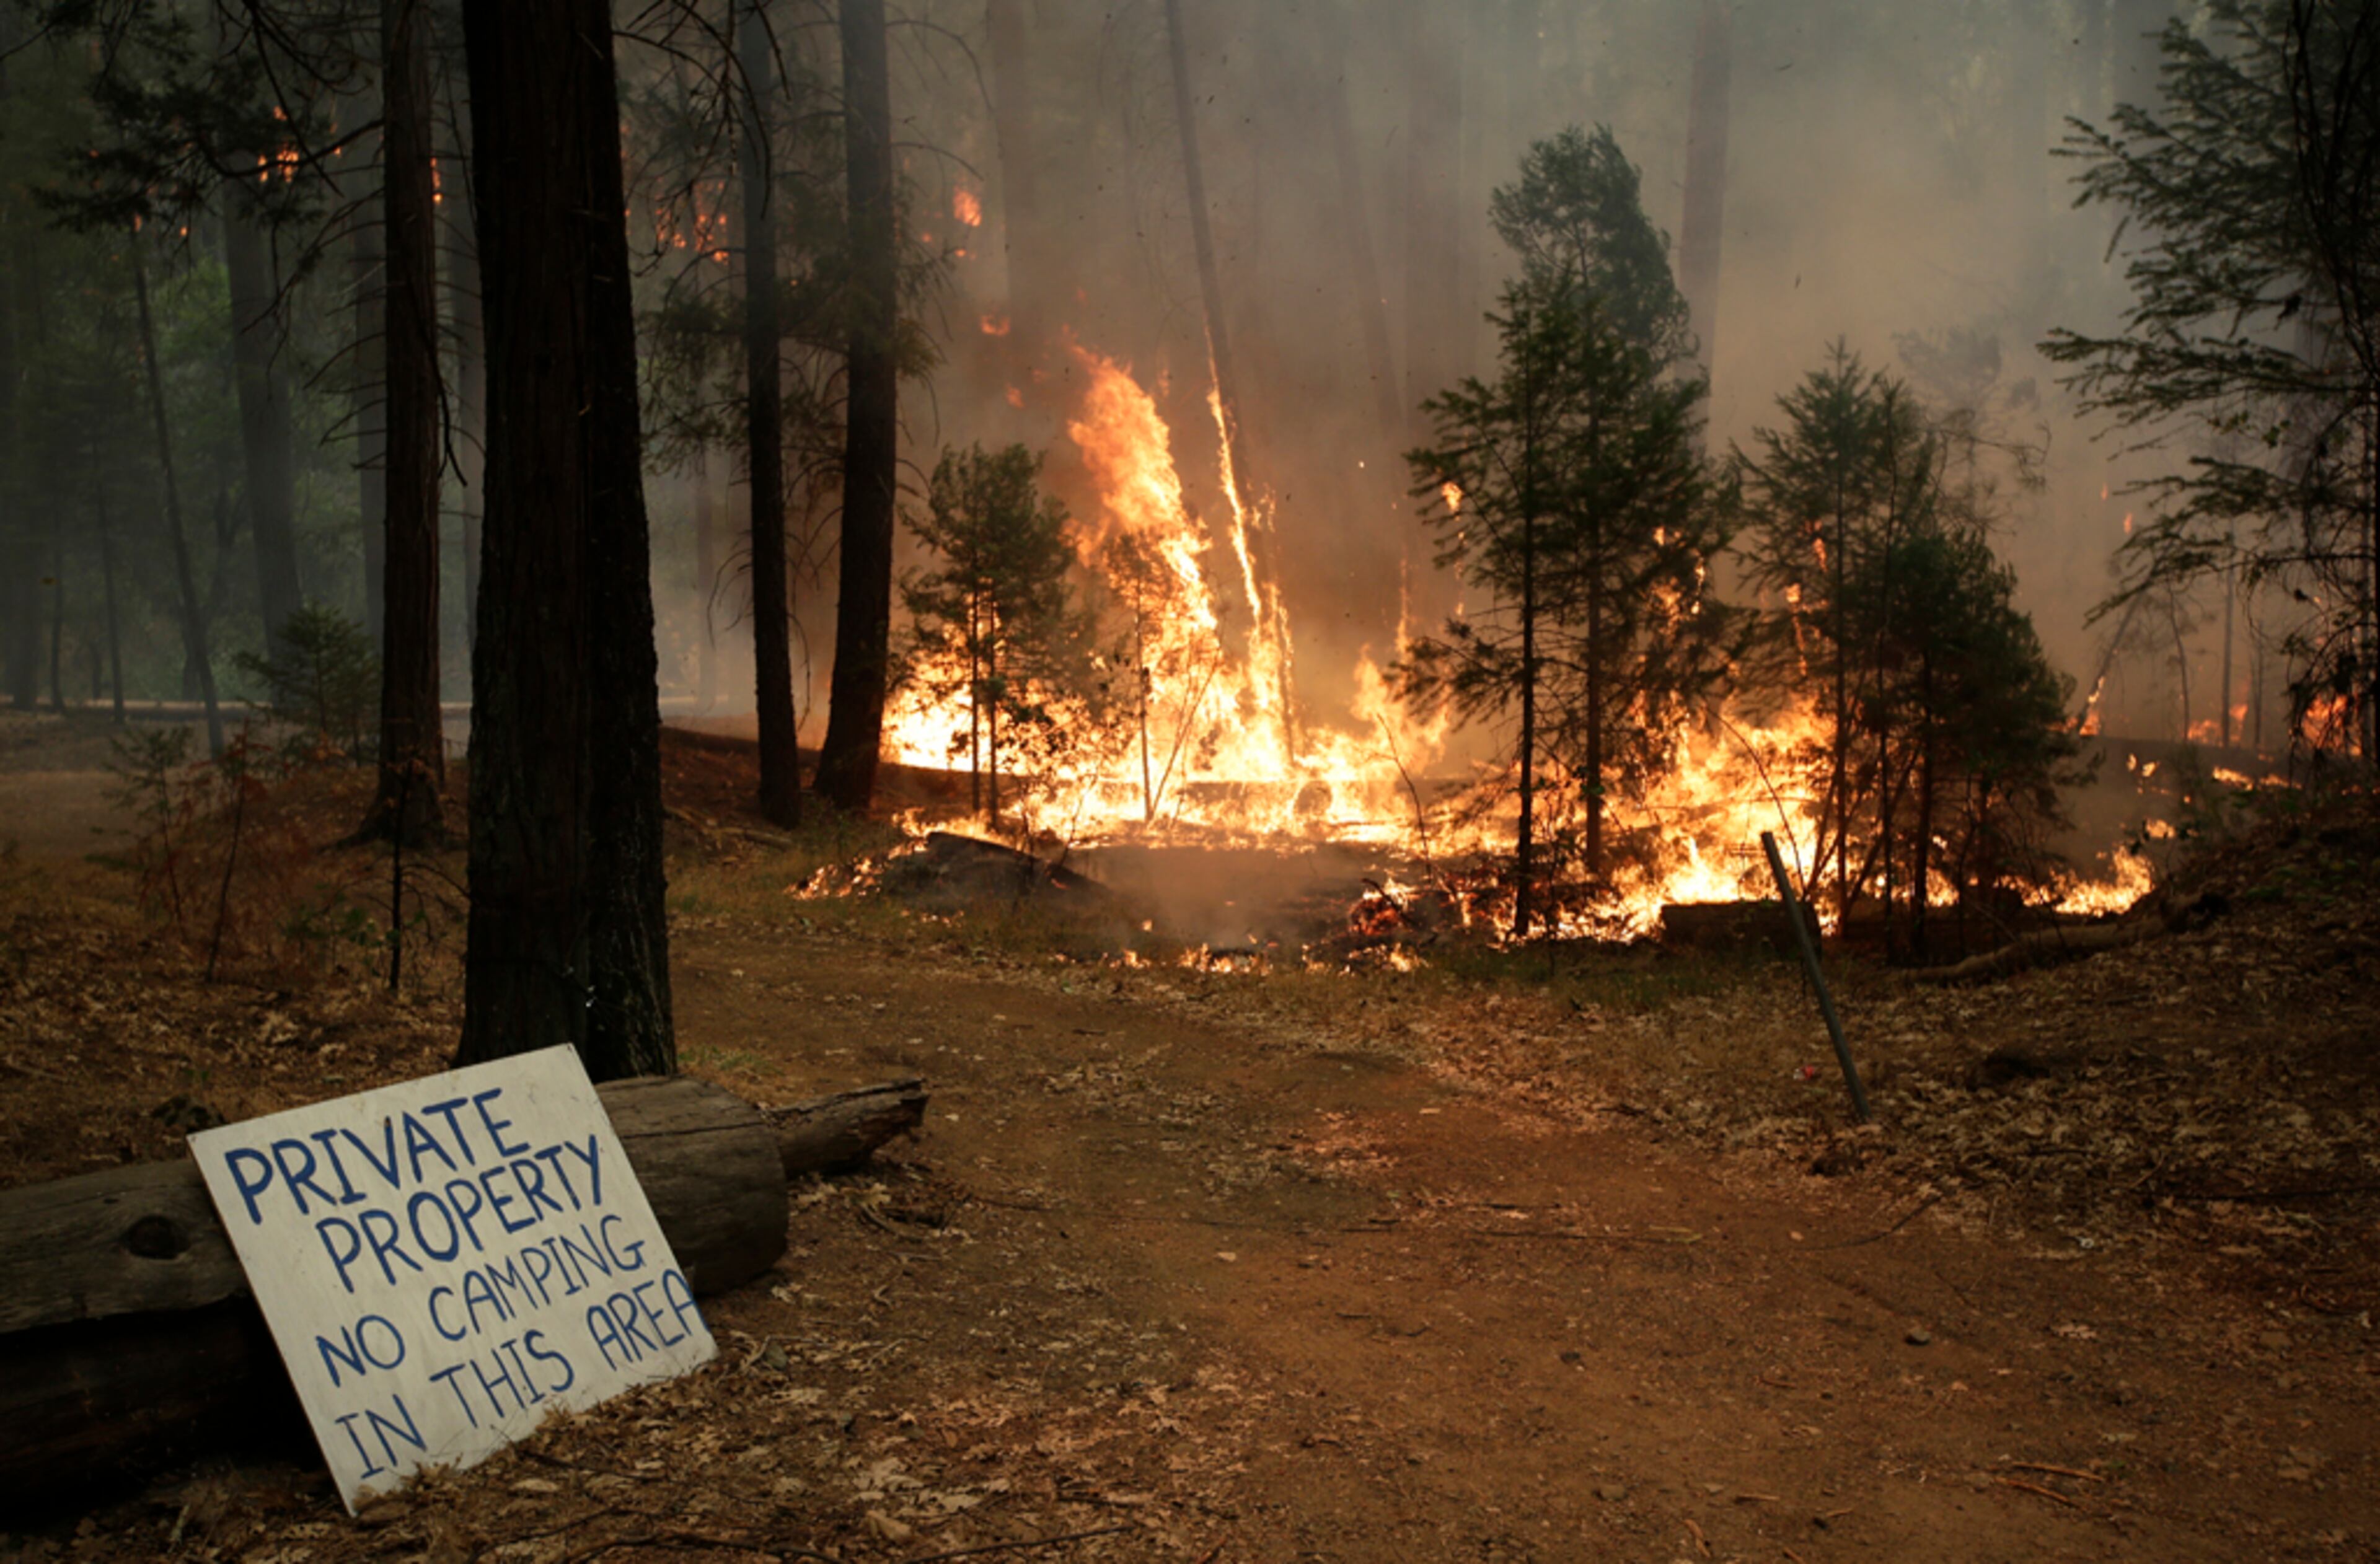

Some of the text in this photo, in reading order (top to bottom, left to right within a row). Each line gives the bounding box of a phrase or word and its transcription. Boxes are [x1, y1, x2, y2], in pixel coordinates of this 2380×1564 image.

[225, 1088, 531, 1224] PRIVATE
[315, 1135, 602, 1294] PROPERTY
[315, 1215, 646, 1387] NO CAMPING
[335, 1268, 712, 1480] IN THIS AREA
